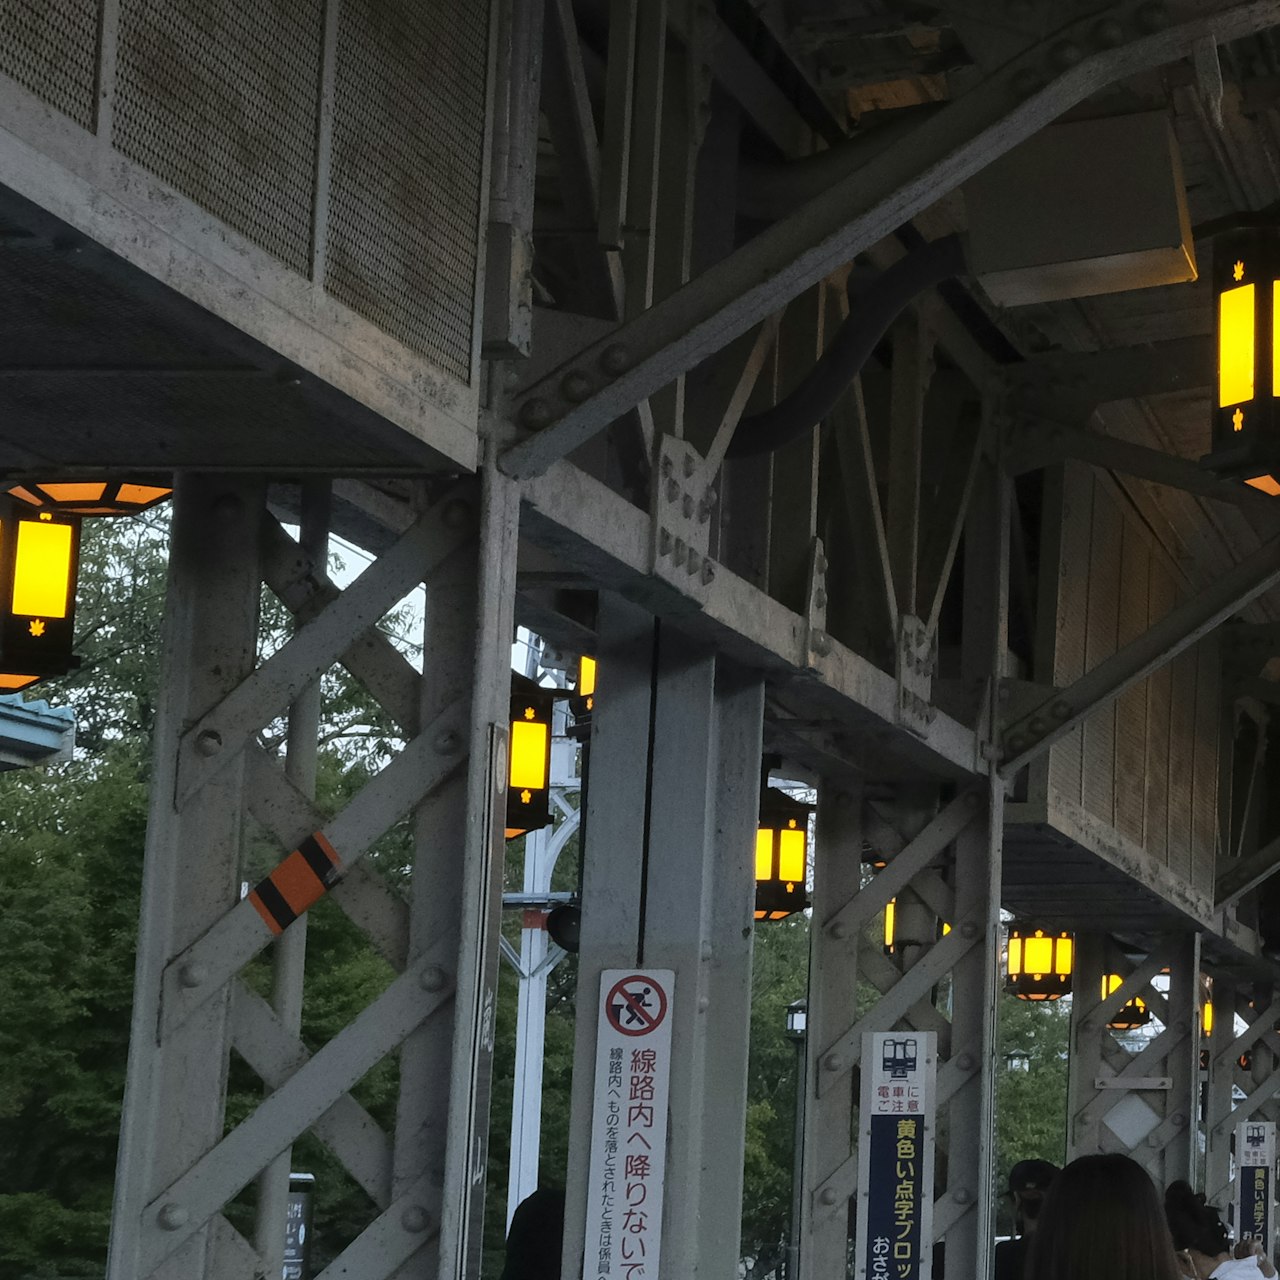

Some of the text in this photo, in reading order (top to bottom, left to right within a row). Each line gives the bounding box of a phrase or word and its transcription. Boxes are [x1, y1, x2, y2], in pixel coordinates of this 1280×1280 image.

[878, 1086, 919, 1098] 電車に
[878, 1100, 919, 1112] ご注意
[620, 1048, 656, 1280] 線路内へ降りないで
[894, 1119, 916, 1278] 黄色い点字ブロッ
